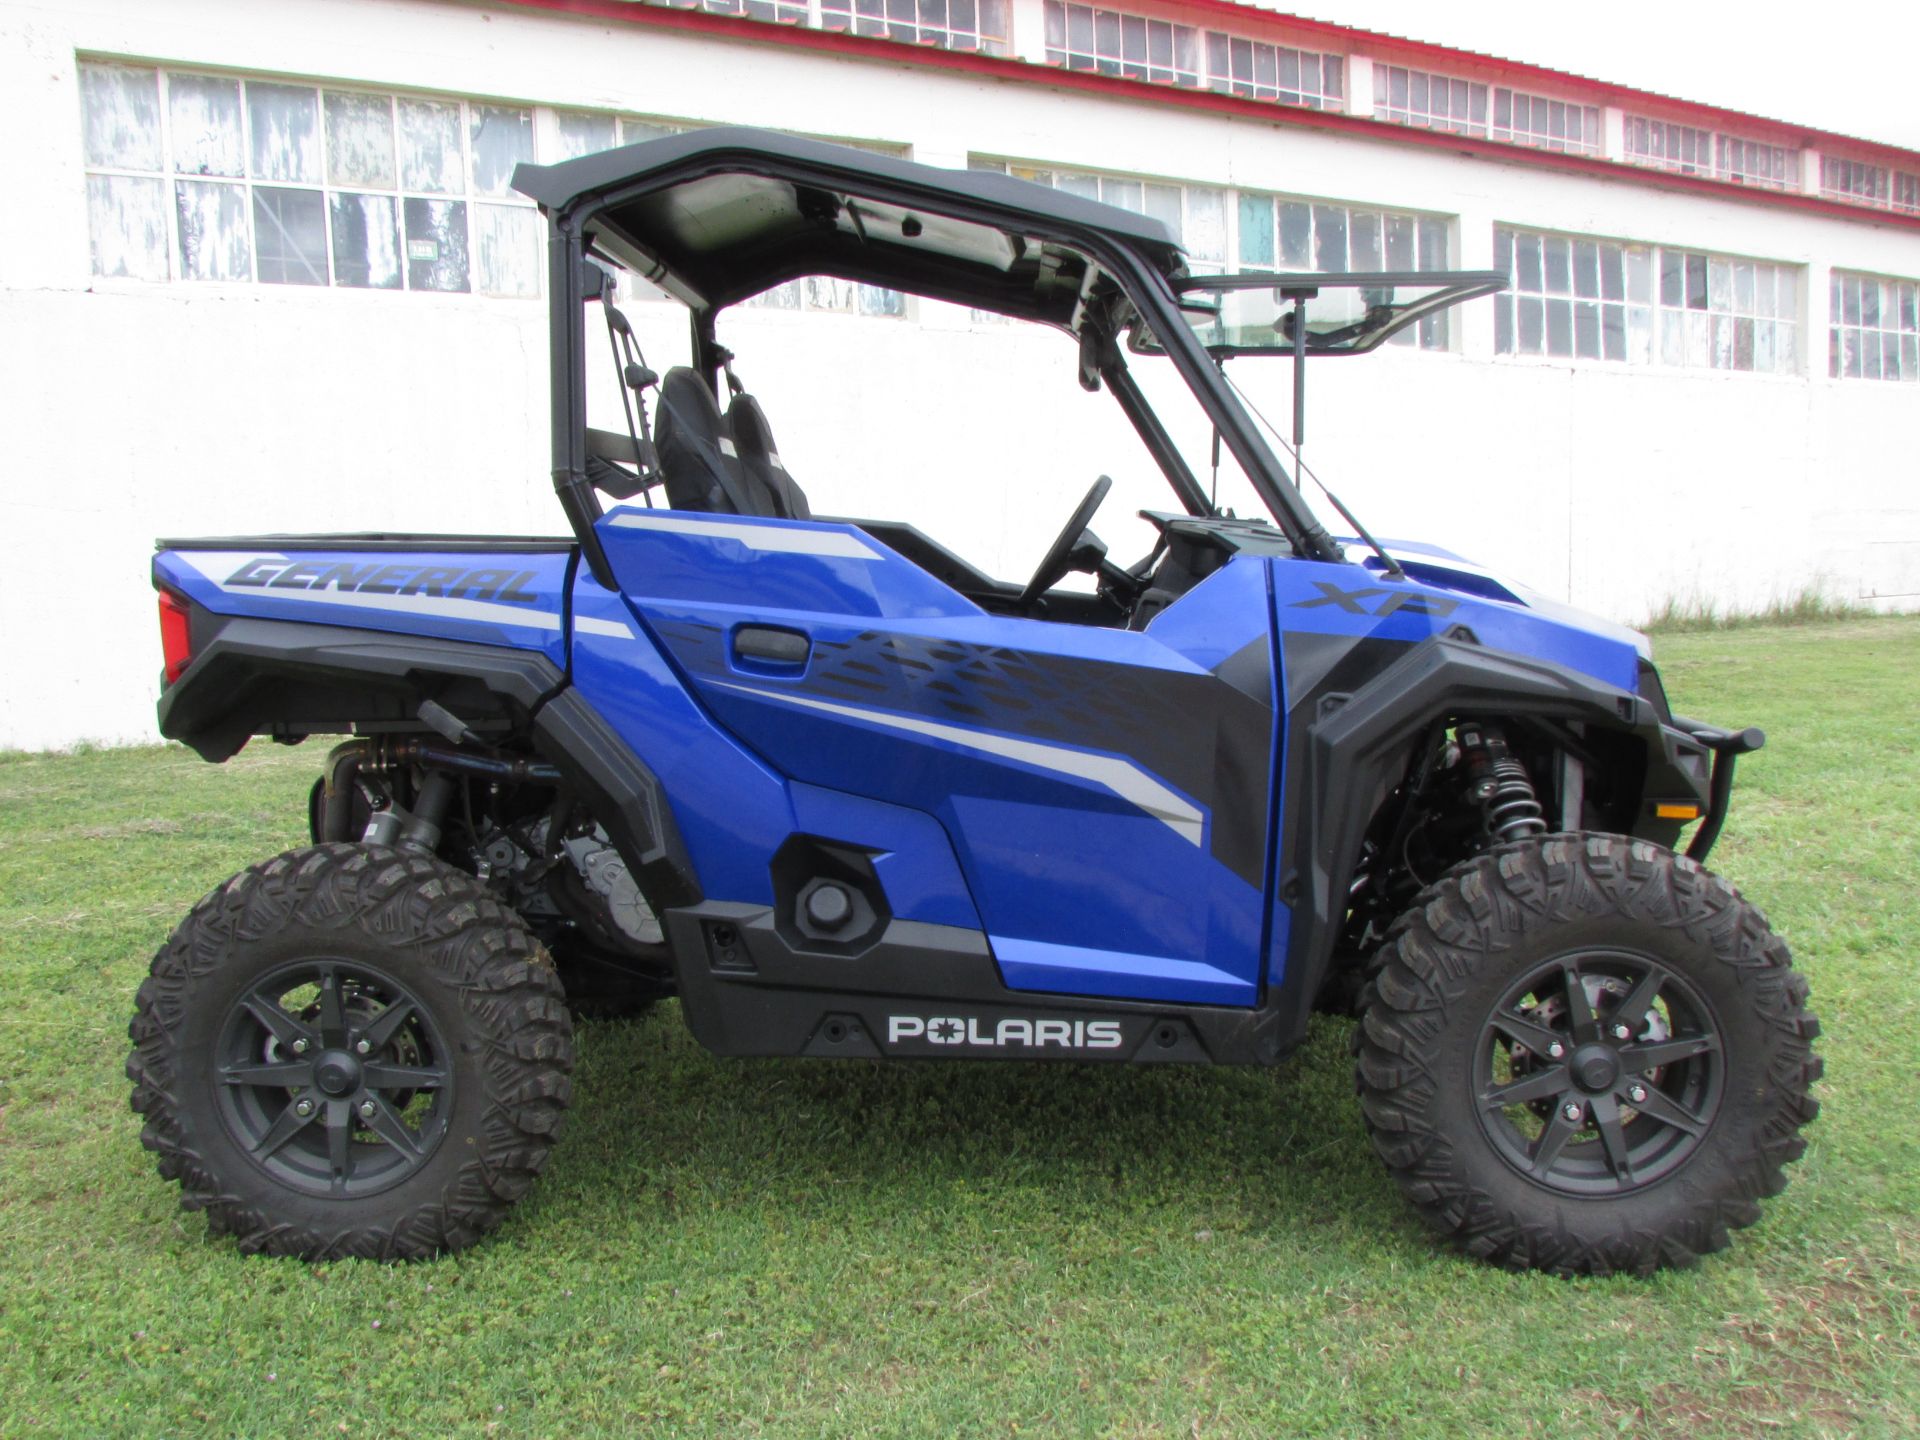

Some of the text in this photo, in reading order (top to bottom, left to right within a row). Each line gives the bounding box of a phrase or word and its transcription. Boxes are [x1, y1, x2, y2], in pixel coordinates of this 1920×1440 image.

[223, 558, 538, 603] GENERAL
[1284, 581, 1461, 618] XP
[888, 1015, 1123, 1048] POLARIS
